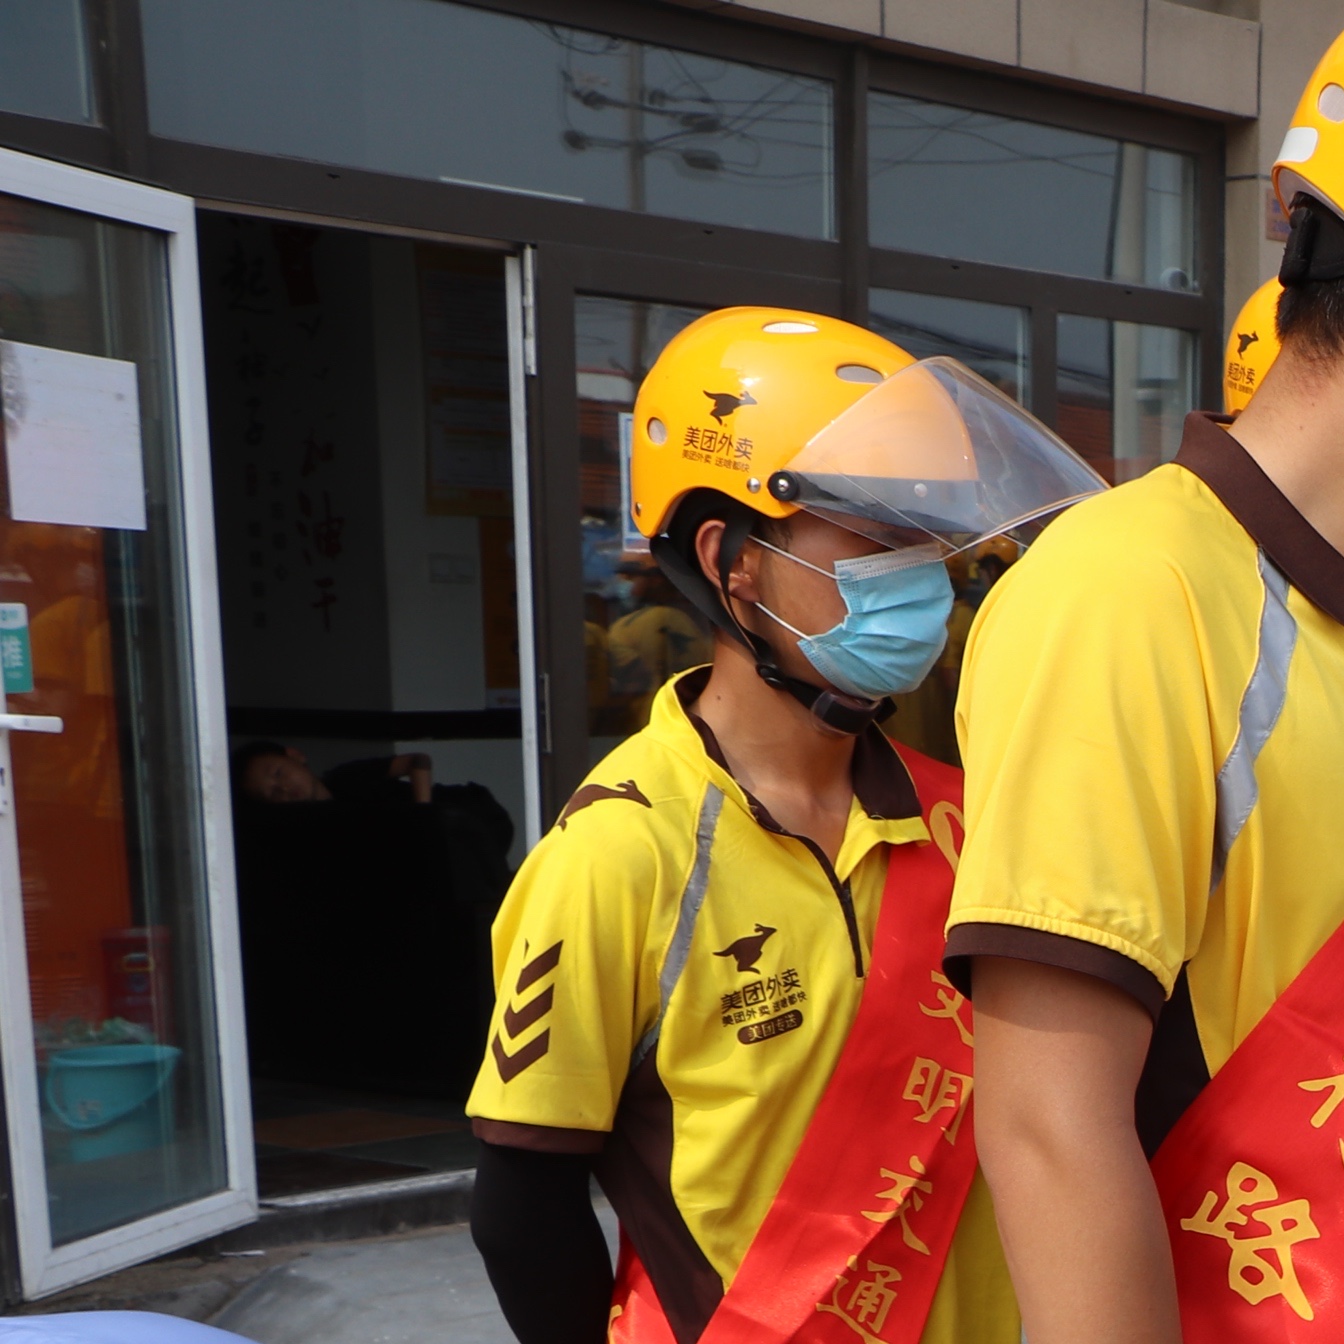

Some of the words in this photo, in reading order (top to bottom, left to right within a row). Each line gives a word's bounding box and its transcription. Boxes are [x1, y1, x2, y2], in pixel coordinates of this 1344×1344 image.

[683, 425, 753, 461] 美团外卖
[720, 968, 801, 1014] 美团外卖
[722, 1006, 771, 1028] 美团外卖
[748, 1013, 798, 1042] 美团专送
